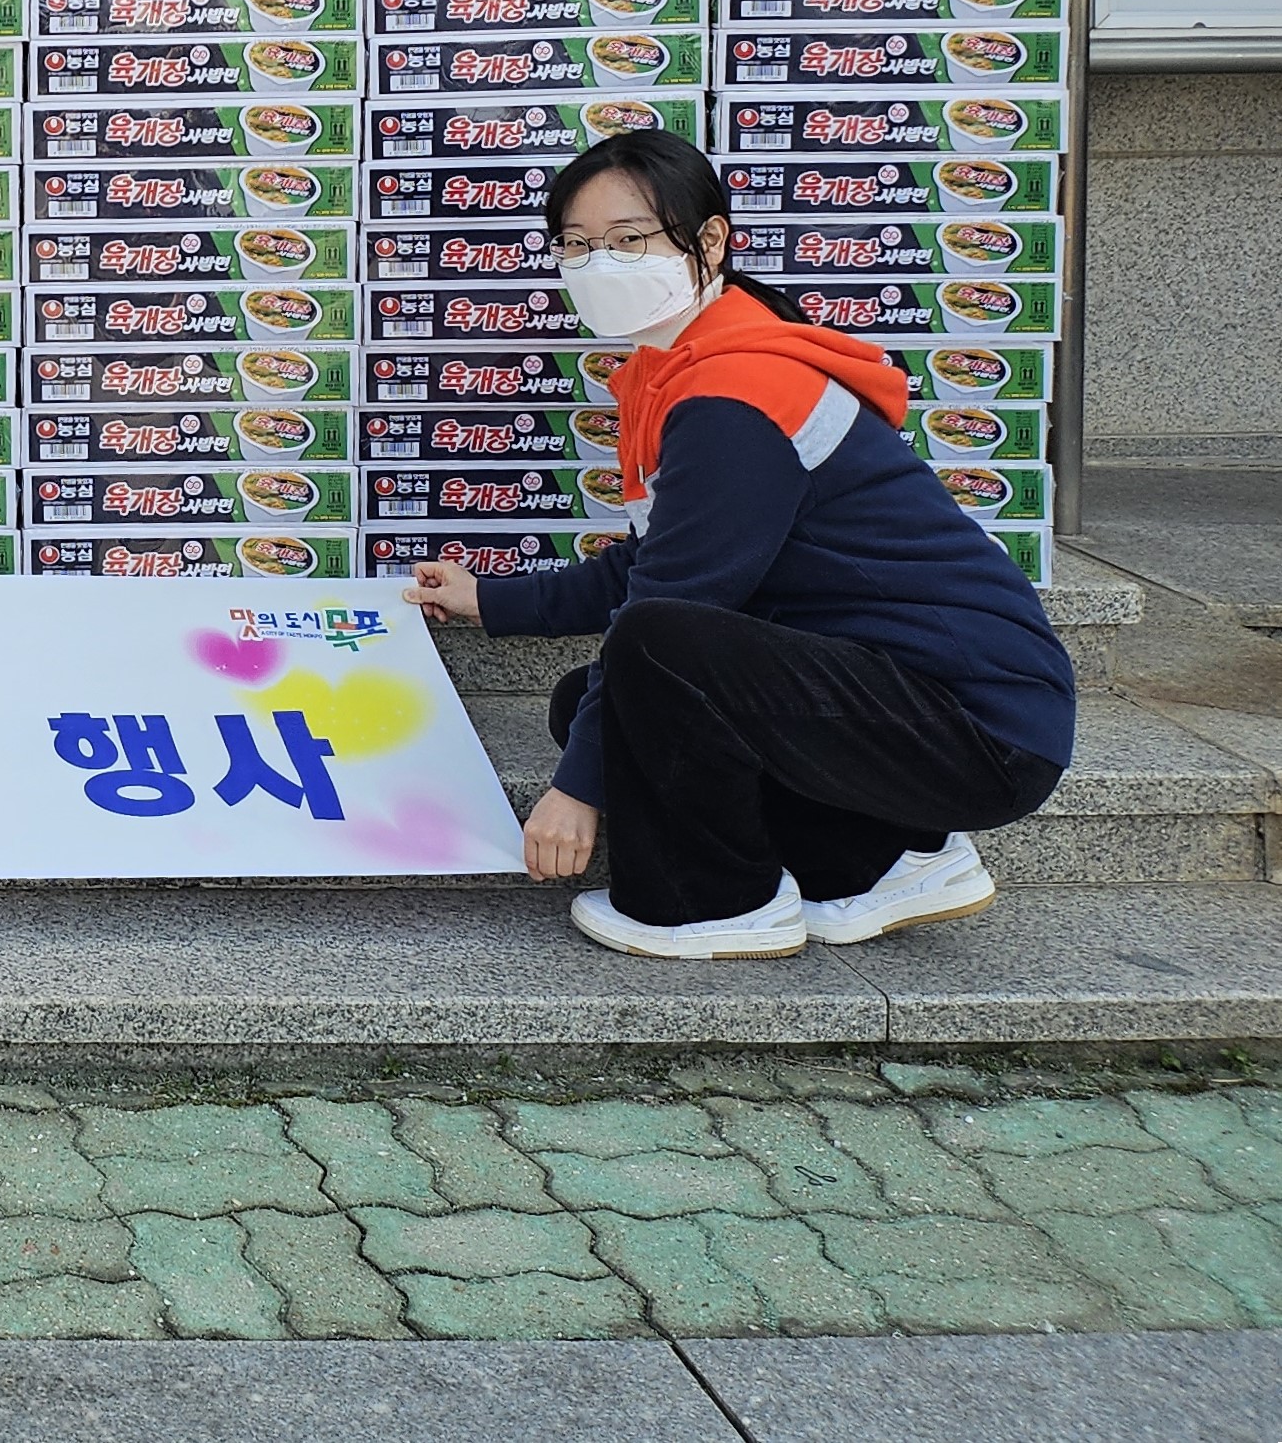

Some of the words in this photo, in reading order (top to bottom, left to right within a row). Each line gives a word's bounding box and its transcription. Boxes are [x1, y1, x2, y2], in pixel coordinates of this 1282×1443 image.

[67, 54, 100, 70] 농심
[109, 52, 189, 87] 육개장
[187, 67, 241, 86] 사발면
[409, 52, 442, 68] 농심
[451, 49, 531, 84] 육개장
[530, 63, 584, 82] 사발면
[750, 171, 784, 188] 농심
[794, 171, 876, 206] 육개장
[875, 187, 929, 206] 사발면
[58, 422, 91, 438] 농심
[100, 420, 180, 455] 육개장
[177, 436, 231, 455] 사발면
[229, 609, 278, 638] 맛의
[285, 611, 321, 630] 도시
[325, 609, 389, 652] 목포
[47, 708, 347, 822] 행사
